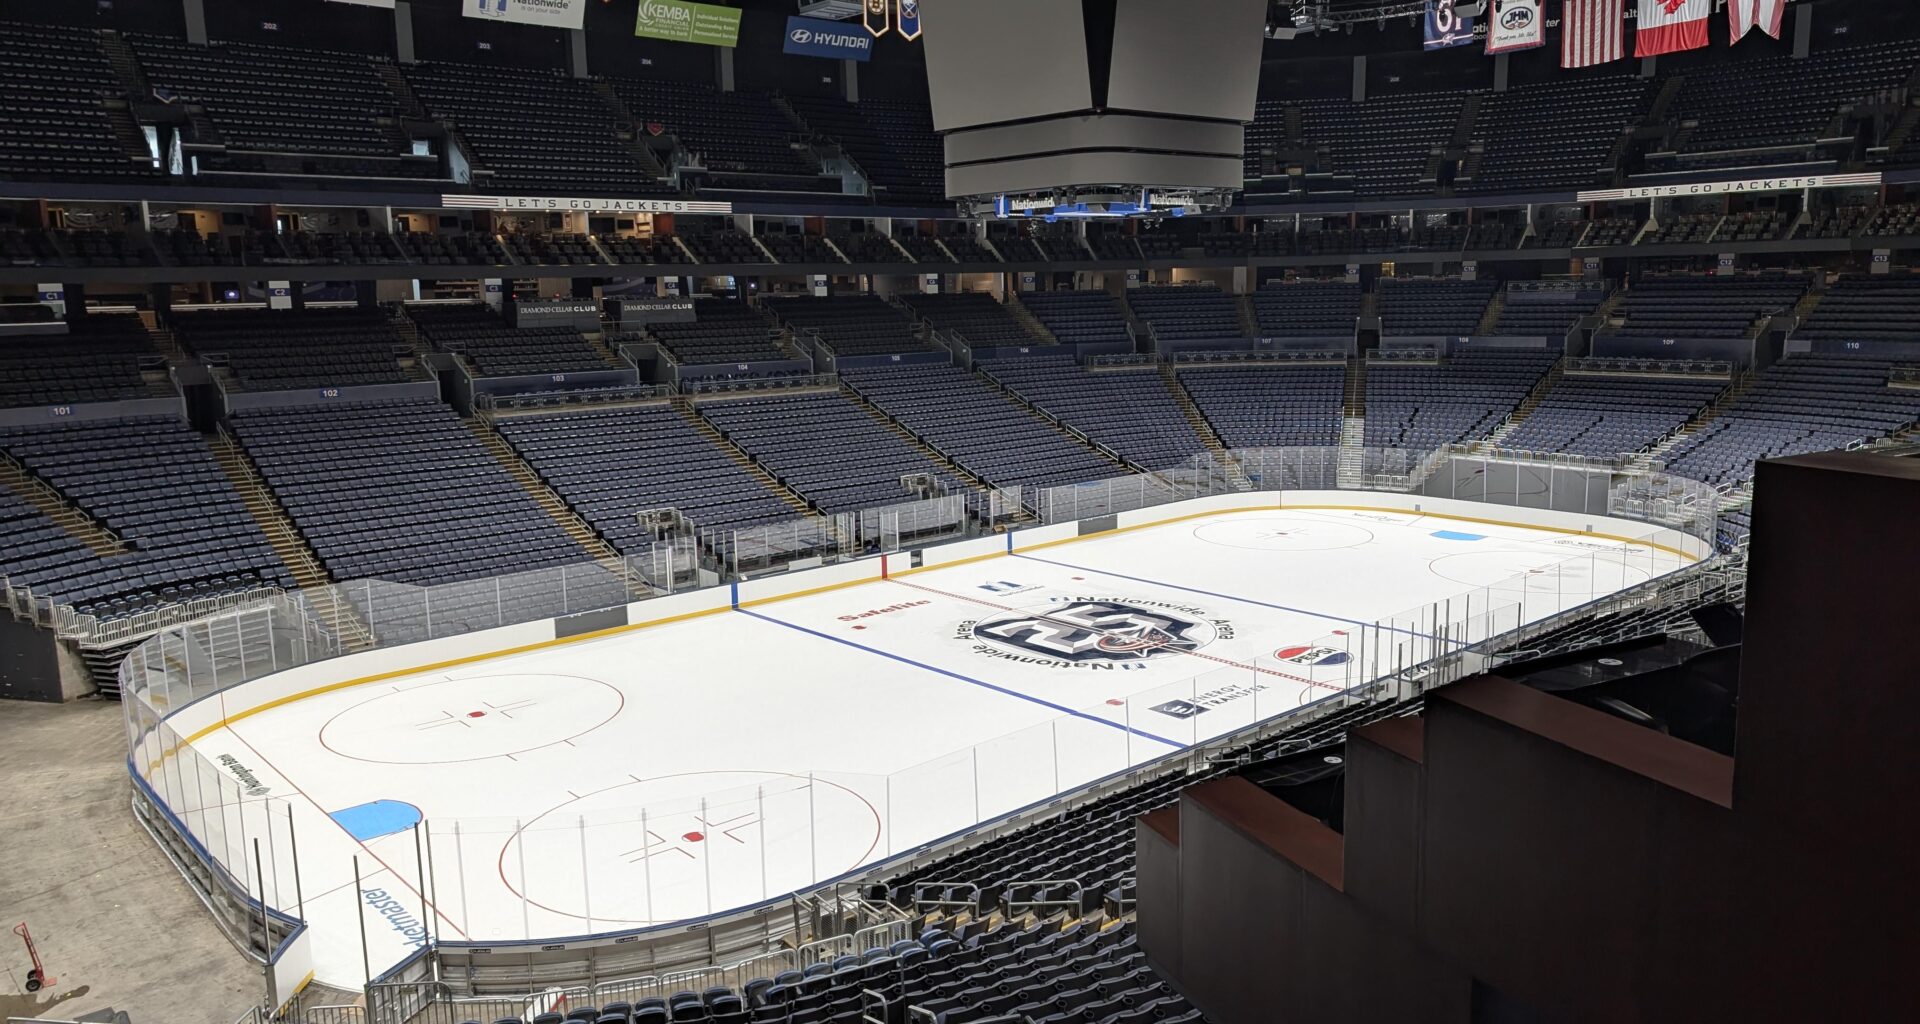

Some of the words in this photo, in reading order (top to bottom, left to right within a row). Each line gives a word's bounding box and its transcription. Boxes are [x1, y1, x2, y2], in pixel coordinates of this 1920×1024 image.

[536, 7, 548, 15] your
[648, 4, 691, 21] KEMBA
[1505, 10, 1530, 25] JHM
[263, 22, 277, 30] 202
[656, 18, 689, 27] FINANCIAL
[1545, 18, 1560, 28] ter
[814, 32, 870, 49] HYUNDAI
[1629, 186, 1677, 197] LET'S
[1690, 184, 1712, 193] GO
[1723, 177, 1816, 191] JACKETS
[504, 198, 556, 208] LET'S
[570, 199, 591, 209] GO
[601, 200, 682, 211] JACKETS
[1012, 196, 1055, 211] Nationwid
[1150, 193, 1194, 206] Nationwide
[46, 292, 57, 300] C1
[274, 288, 285, 296] C2
[520, 306, 550, 314] DIAMOND
[624, 303, 651, 311] DIAMOND
[1846, 342, 1860, 350] 110
[552, 375, 565, 383] 103
[322, 389, 338, 398] 102
[53, 407, 71, 416] 101
[837, 600, 931, 622] Safelite
[1076, 596, 1206, 616] Nationwide
[953, 620, 977, 640] Arena
[1210, 619, 1236, 641] Arena
[972, 644, 1114, 670] Nationwide
[1288, 647, 1338, 664] PEPSI
[1188, 684, 1242, 704] ENERGY
[1202, 684, 1271, 707] TRANSFER
